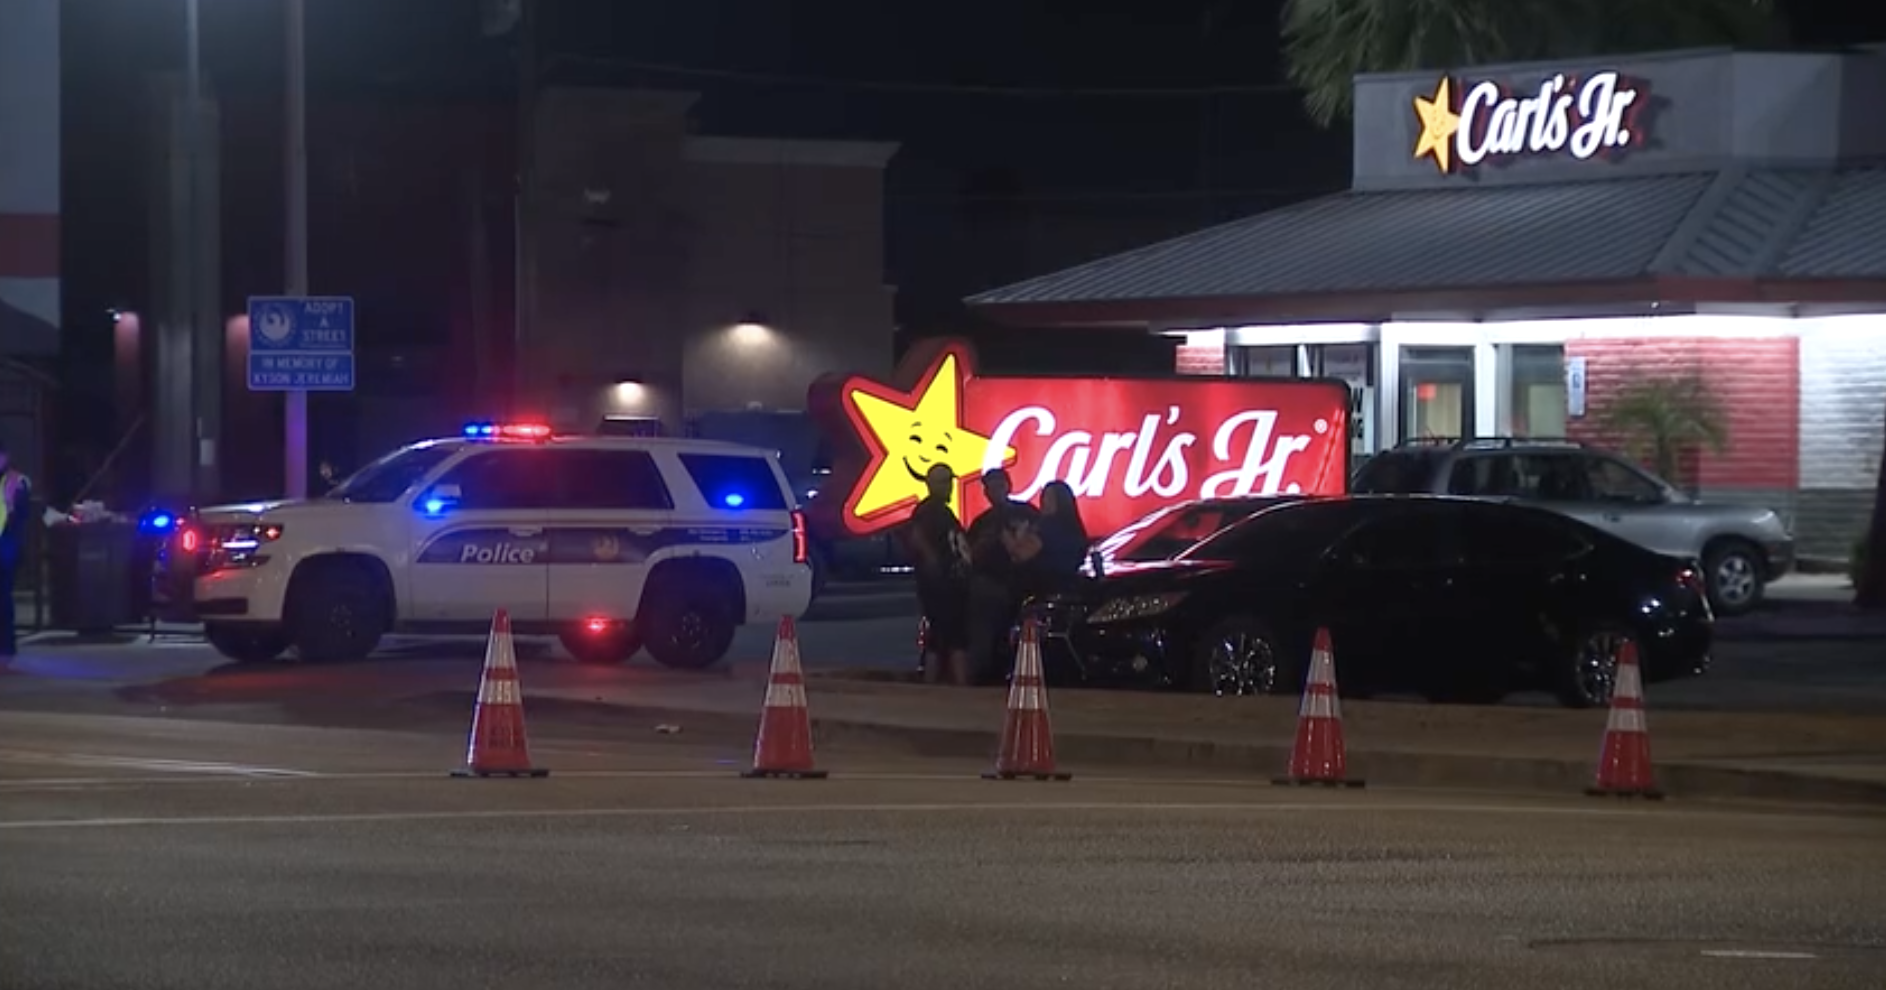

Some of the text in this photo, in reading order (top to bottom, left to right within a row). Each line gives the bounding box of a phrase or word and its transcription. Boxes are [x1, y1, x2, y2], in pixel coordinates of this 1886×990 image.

[1457, 72, 1636, 164] Carl's Jr.
[305, 302, 343, 314] ADOPT
[319, 316, 330, 328] A
[302, 329, 345, 341] STREET
[262, 358, 338, 369] IN MEMORY OF
[982, 406, 1196, 500] Carl's
[1200, 410, 1311, 499] Jr.
[461, 542, 534, 563] Police
